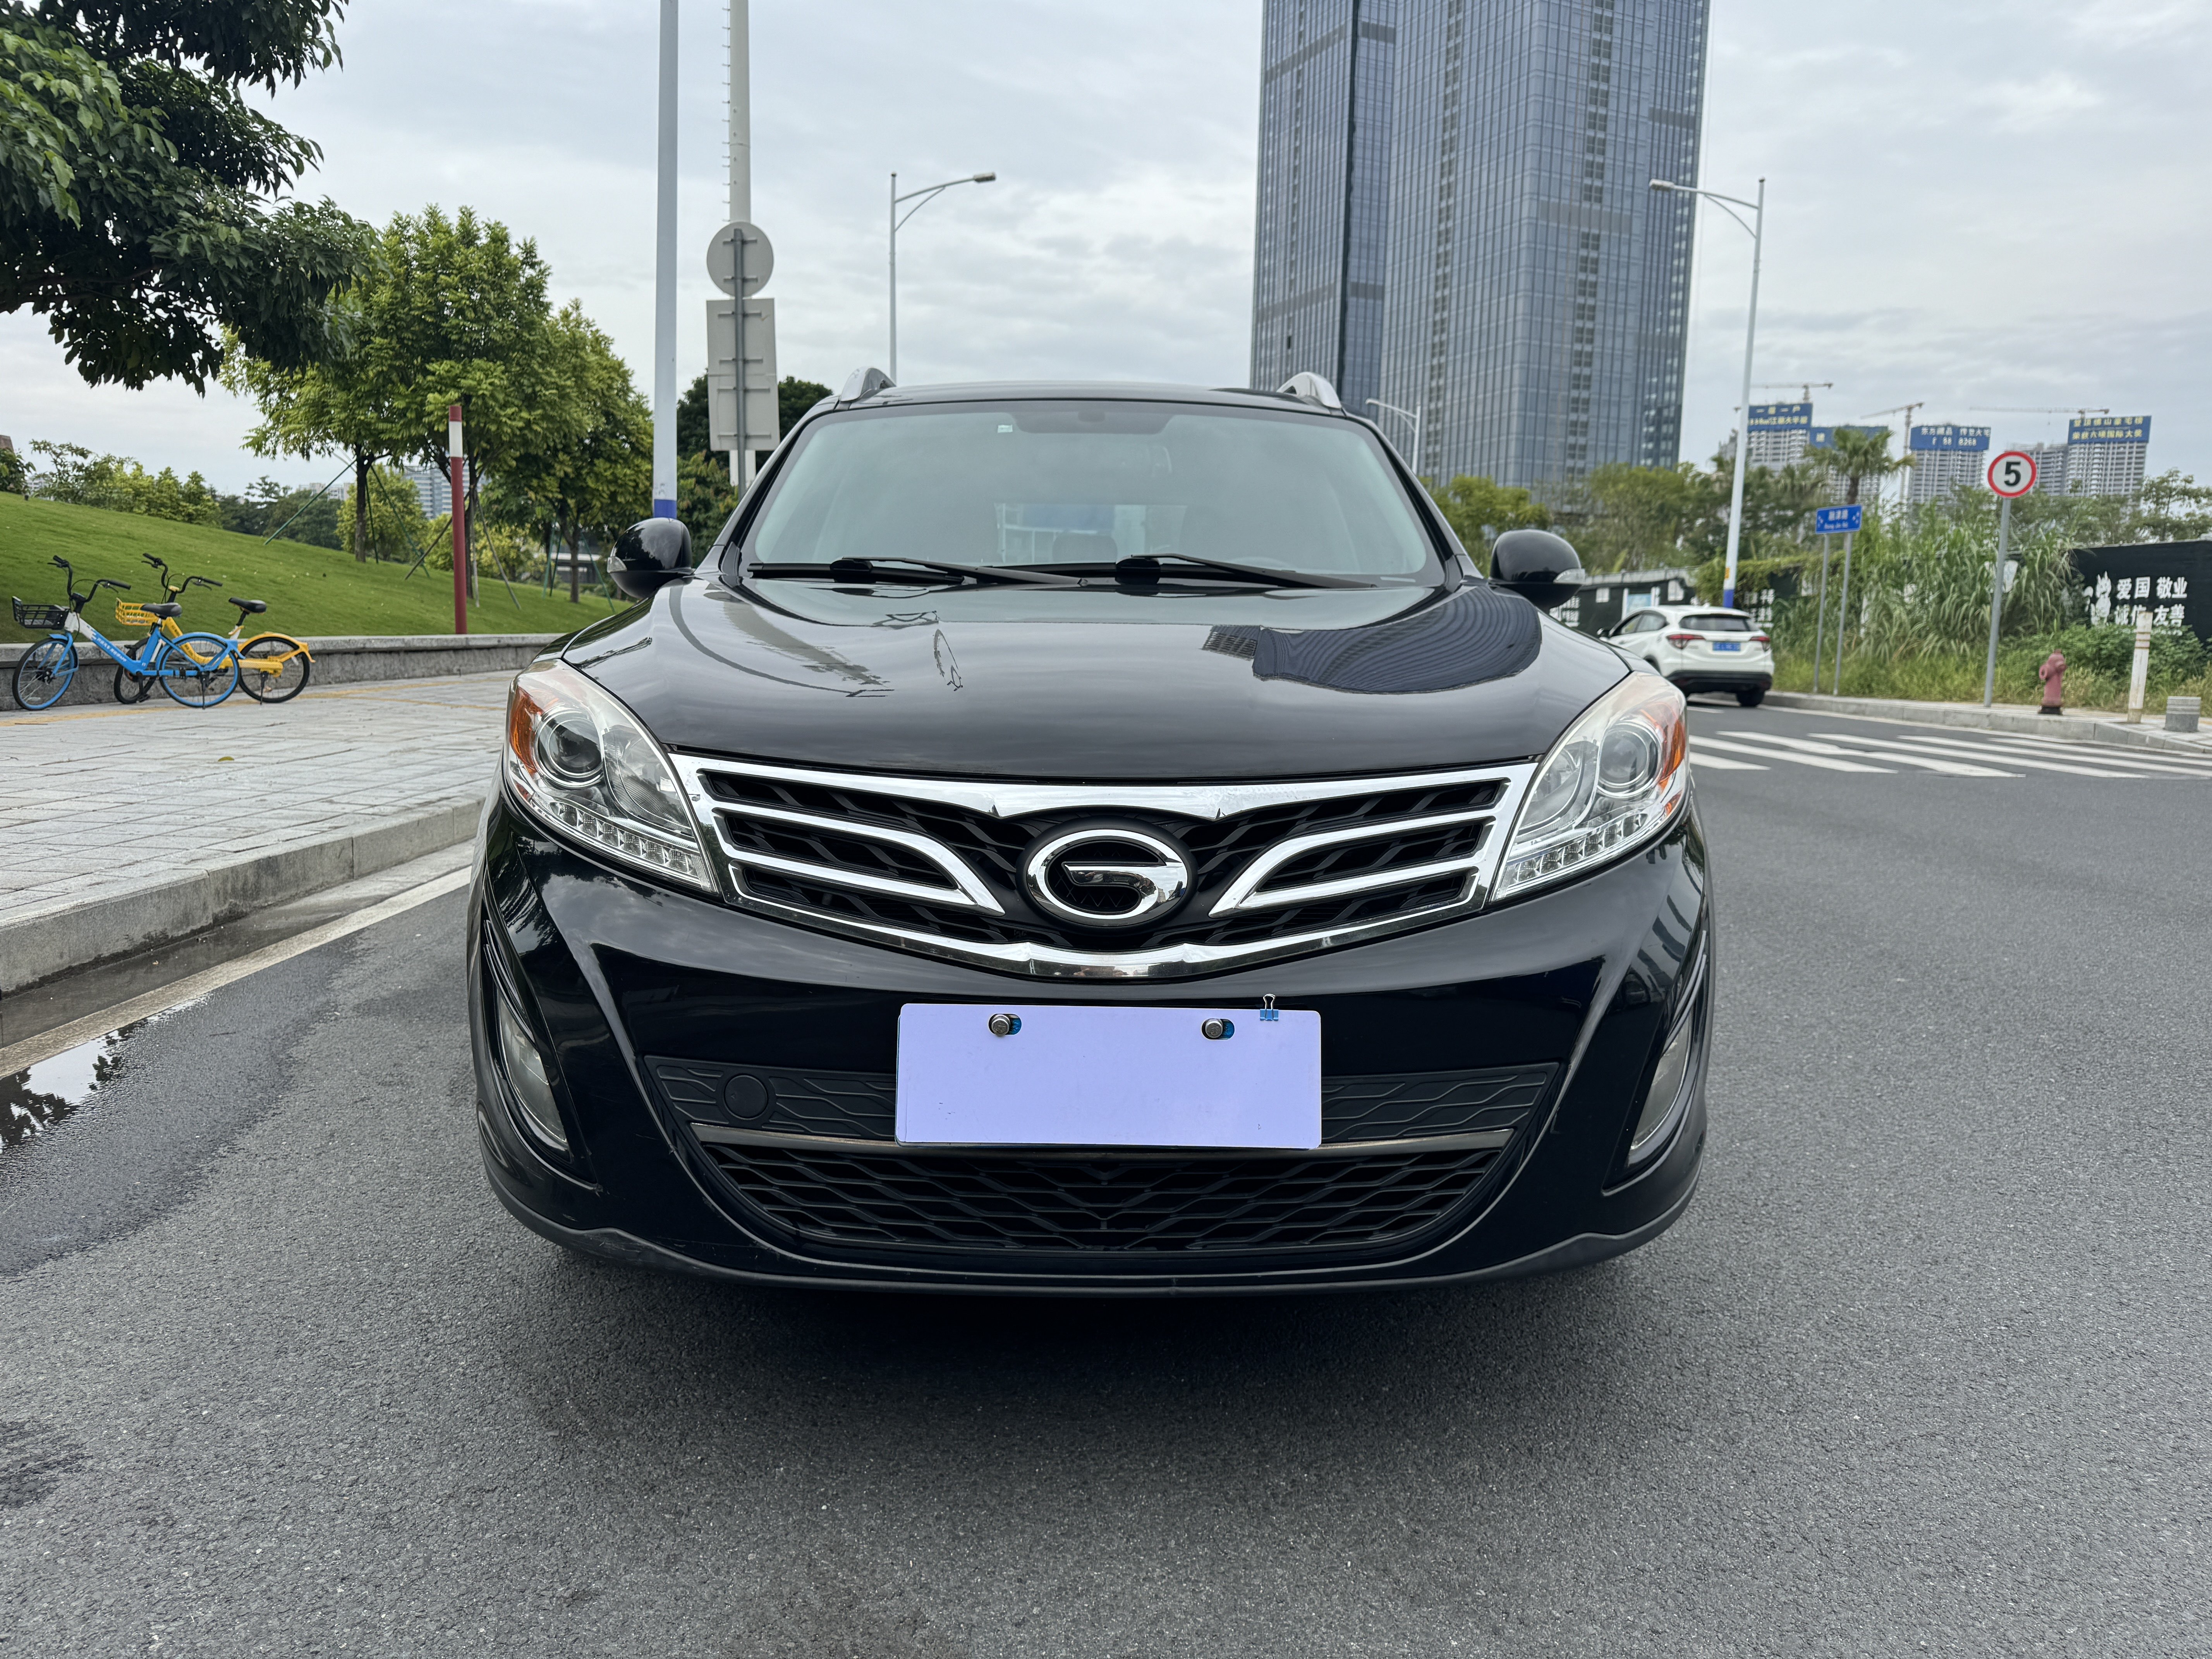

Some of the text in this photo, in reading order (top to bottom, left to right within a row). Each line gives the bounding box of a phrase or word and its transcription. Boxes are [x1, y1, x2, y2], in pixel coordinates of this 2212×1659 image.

[2004, 461, 2021, 486] 5
[2116, 577, 2187, 599] 爱国 敬业
[2153, 604, 2185, 627] 友善
